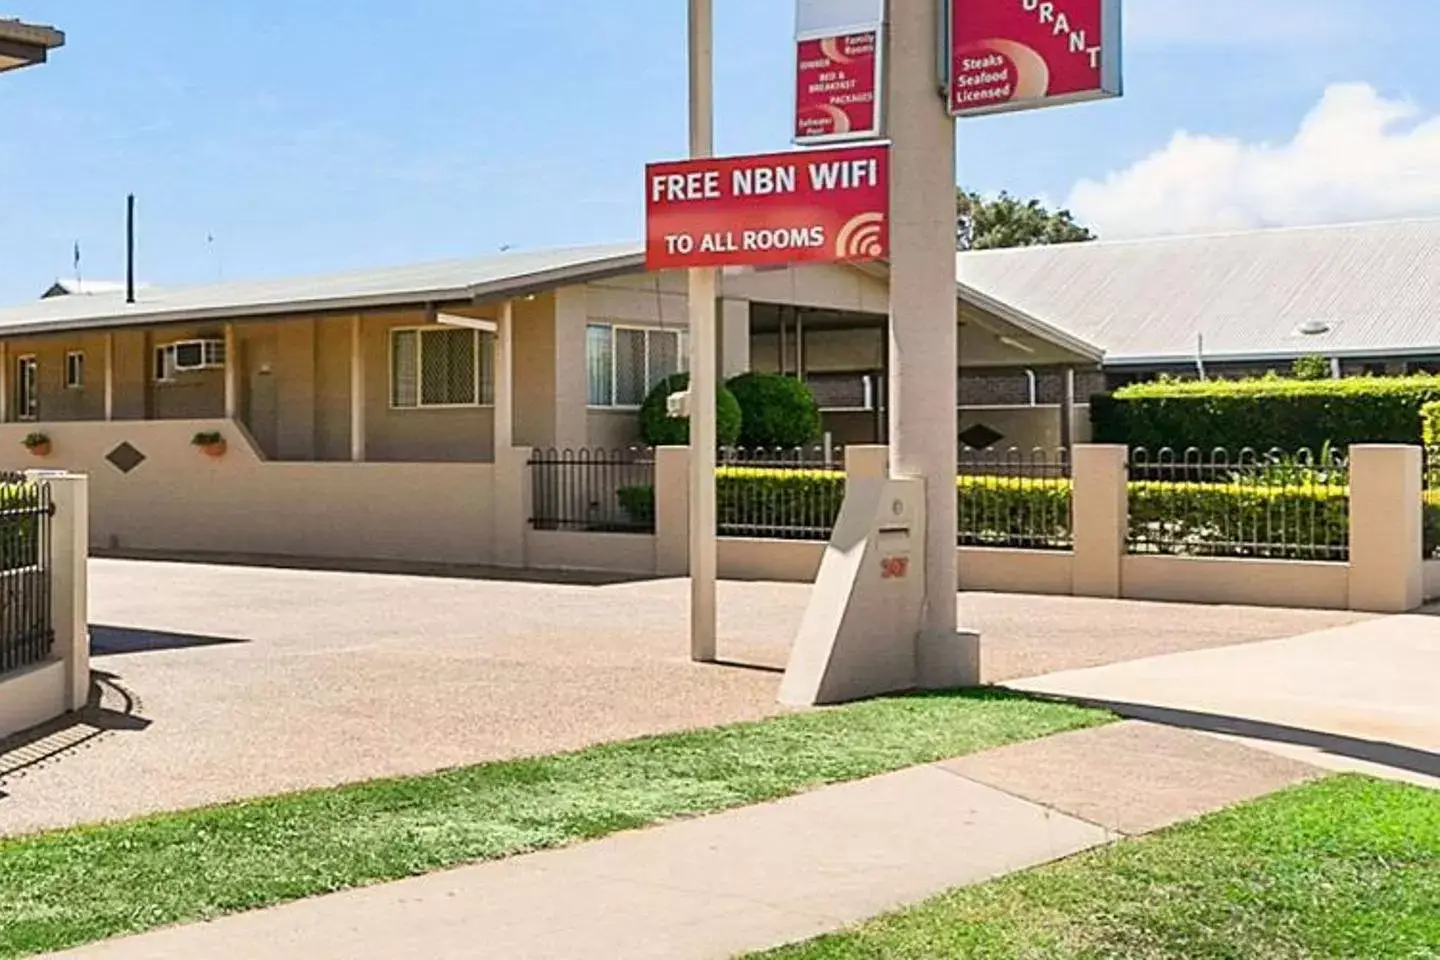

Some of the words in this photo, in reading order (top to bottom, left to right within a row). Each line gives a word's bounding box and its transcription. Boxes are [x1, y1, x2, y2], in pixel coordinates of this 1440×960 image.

[962, 54, 1004, 71] Steaks
[957, 69, 1008, 87] Seafood
[956, 85, 1010, 104] Licensed
[651, 171, 721, 203] FREE
[732, 165, 796, 197] NBN
[809, 158, 877, 191] WIFI
[664, 234, 694, 255] TO
[699, 231, 739, 253] ALL
[743, 226, 825, 250] ROOMS
